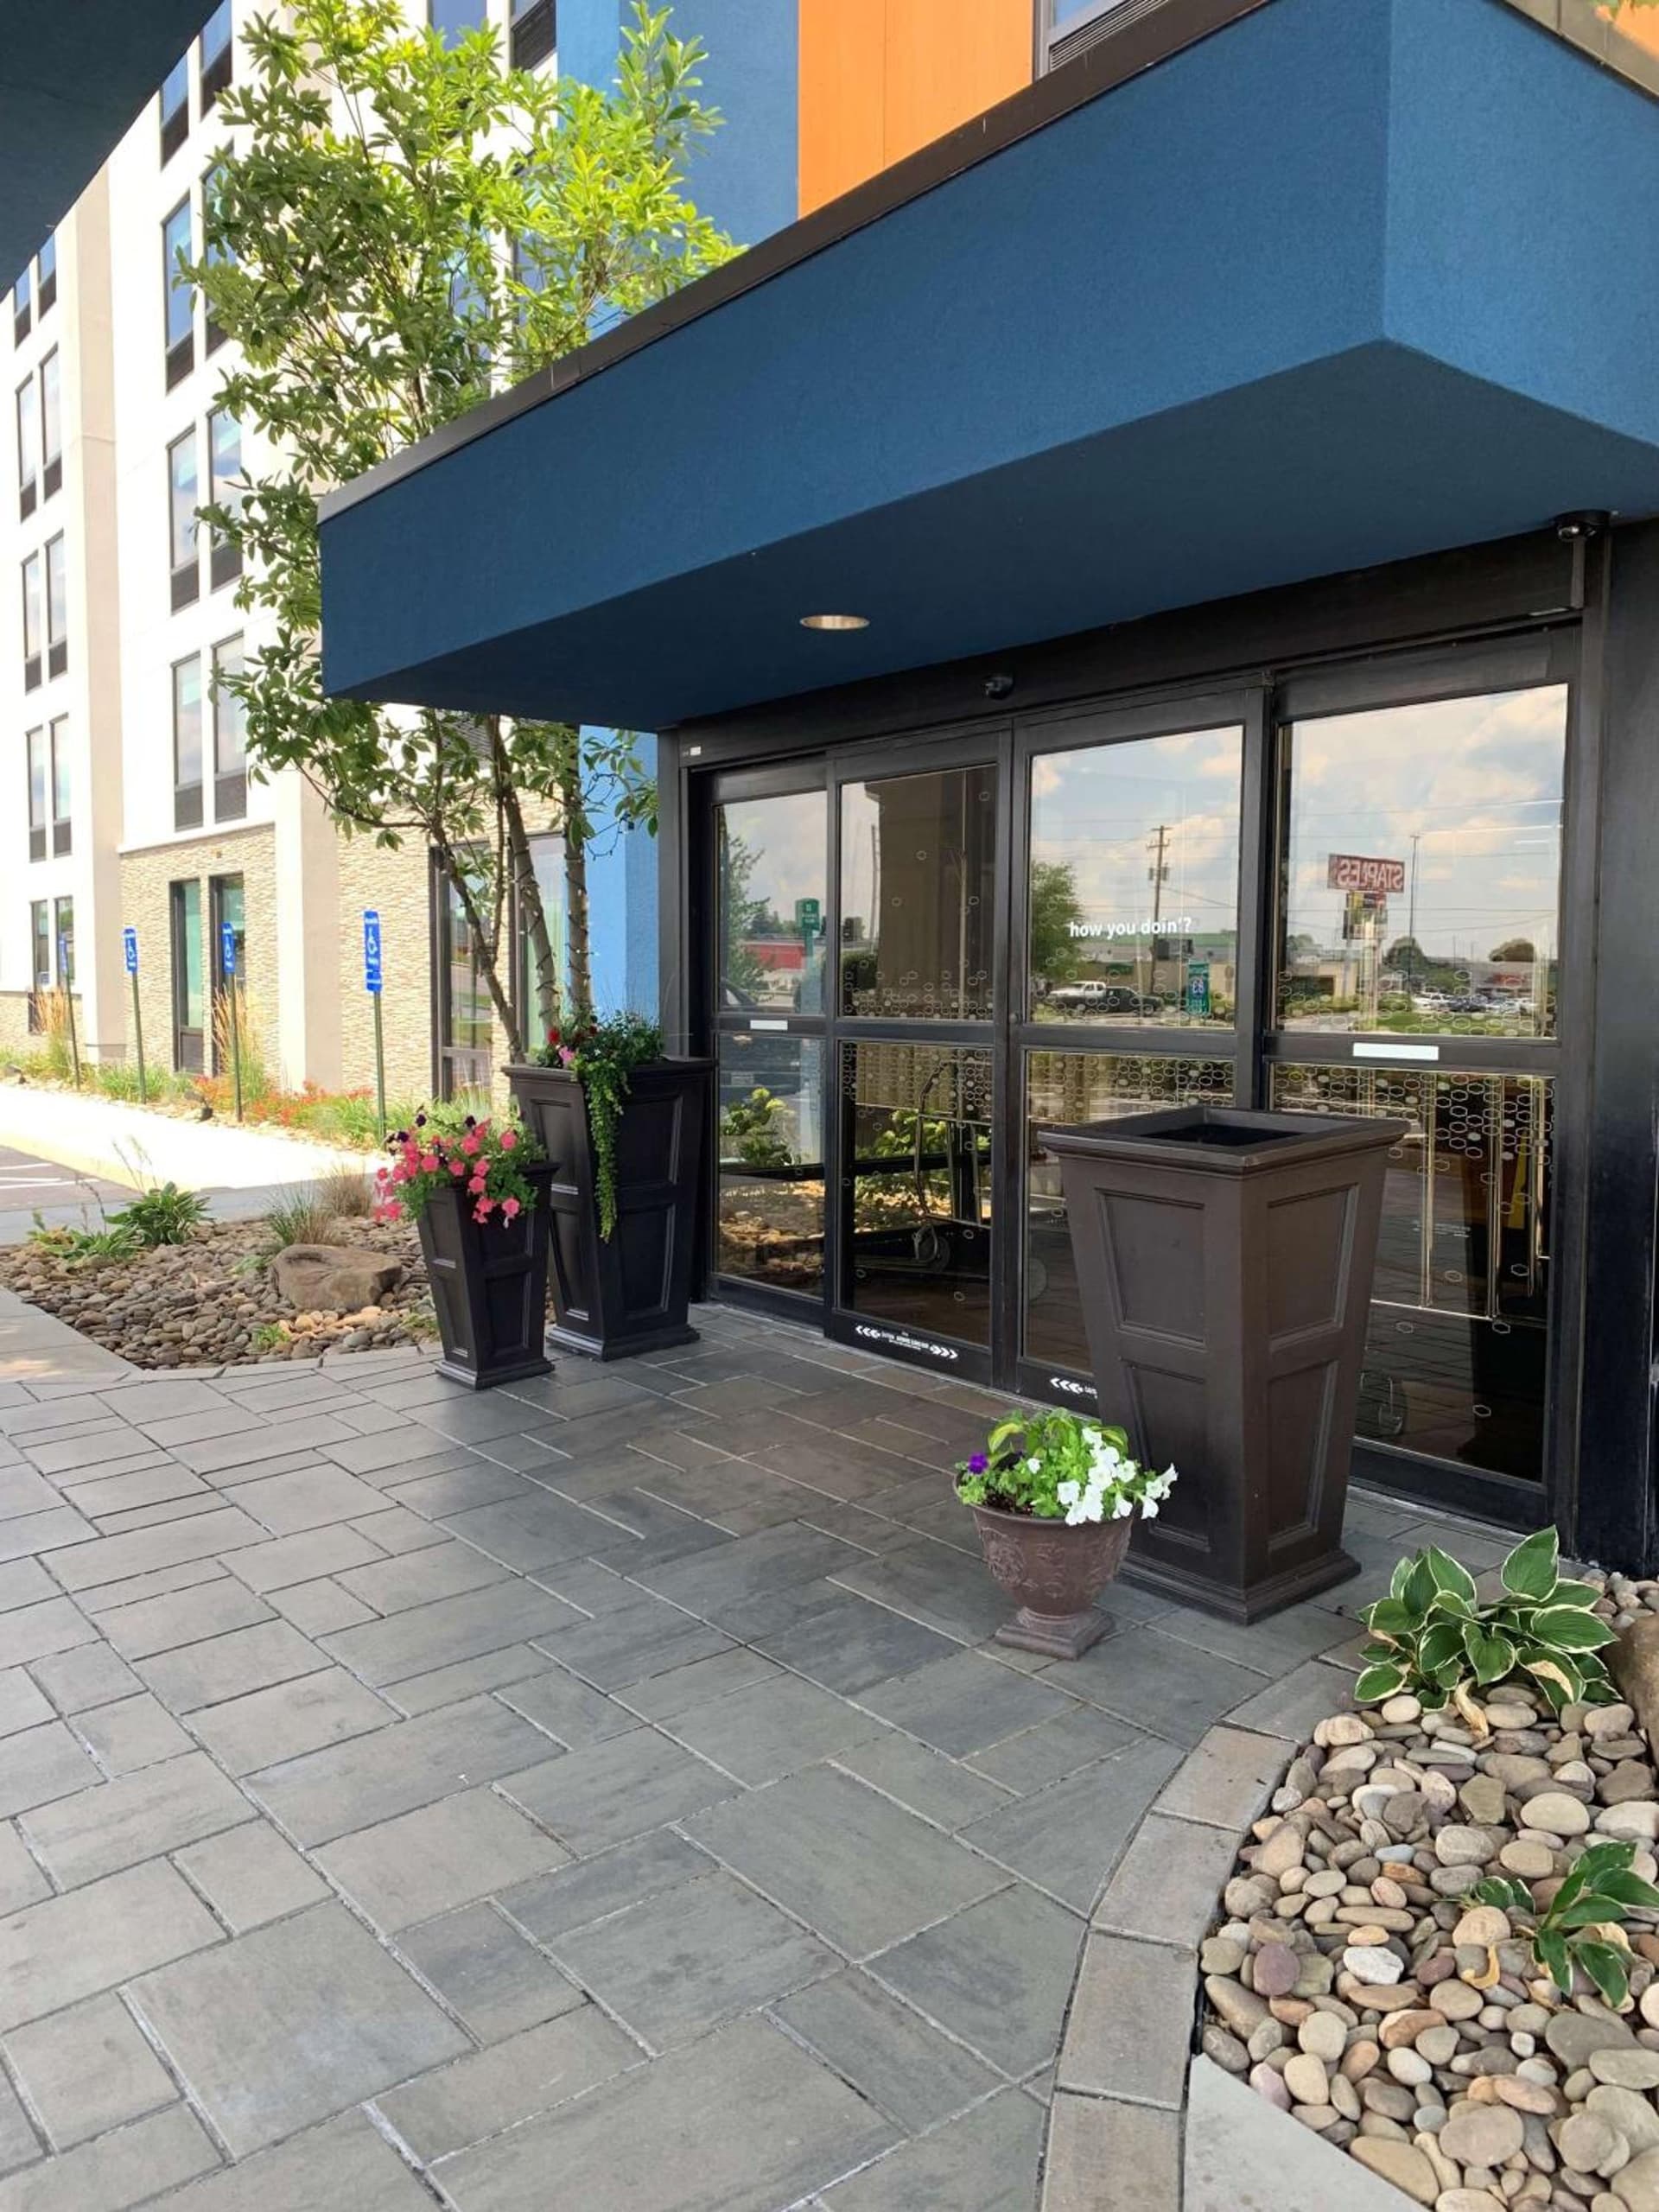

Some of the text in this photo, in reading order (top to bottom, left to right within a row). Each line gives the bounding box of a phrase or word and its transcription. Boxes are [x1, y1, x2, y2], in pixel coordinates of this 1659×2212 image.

[1070, 917, 1192, 940] how you doin'?
